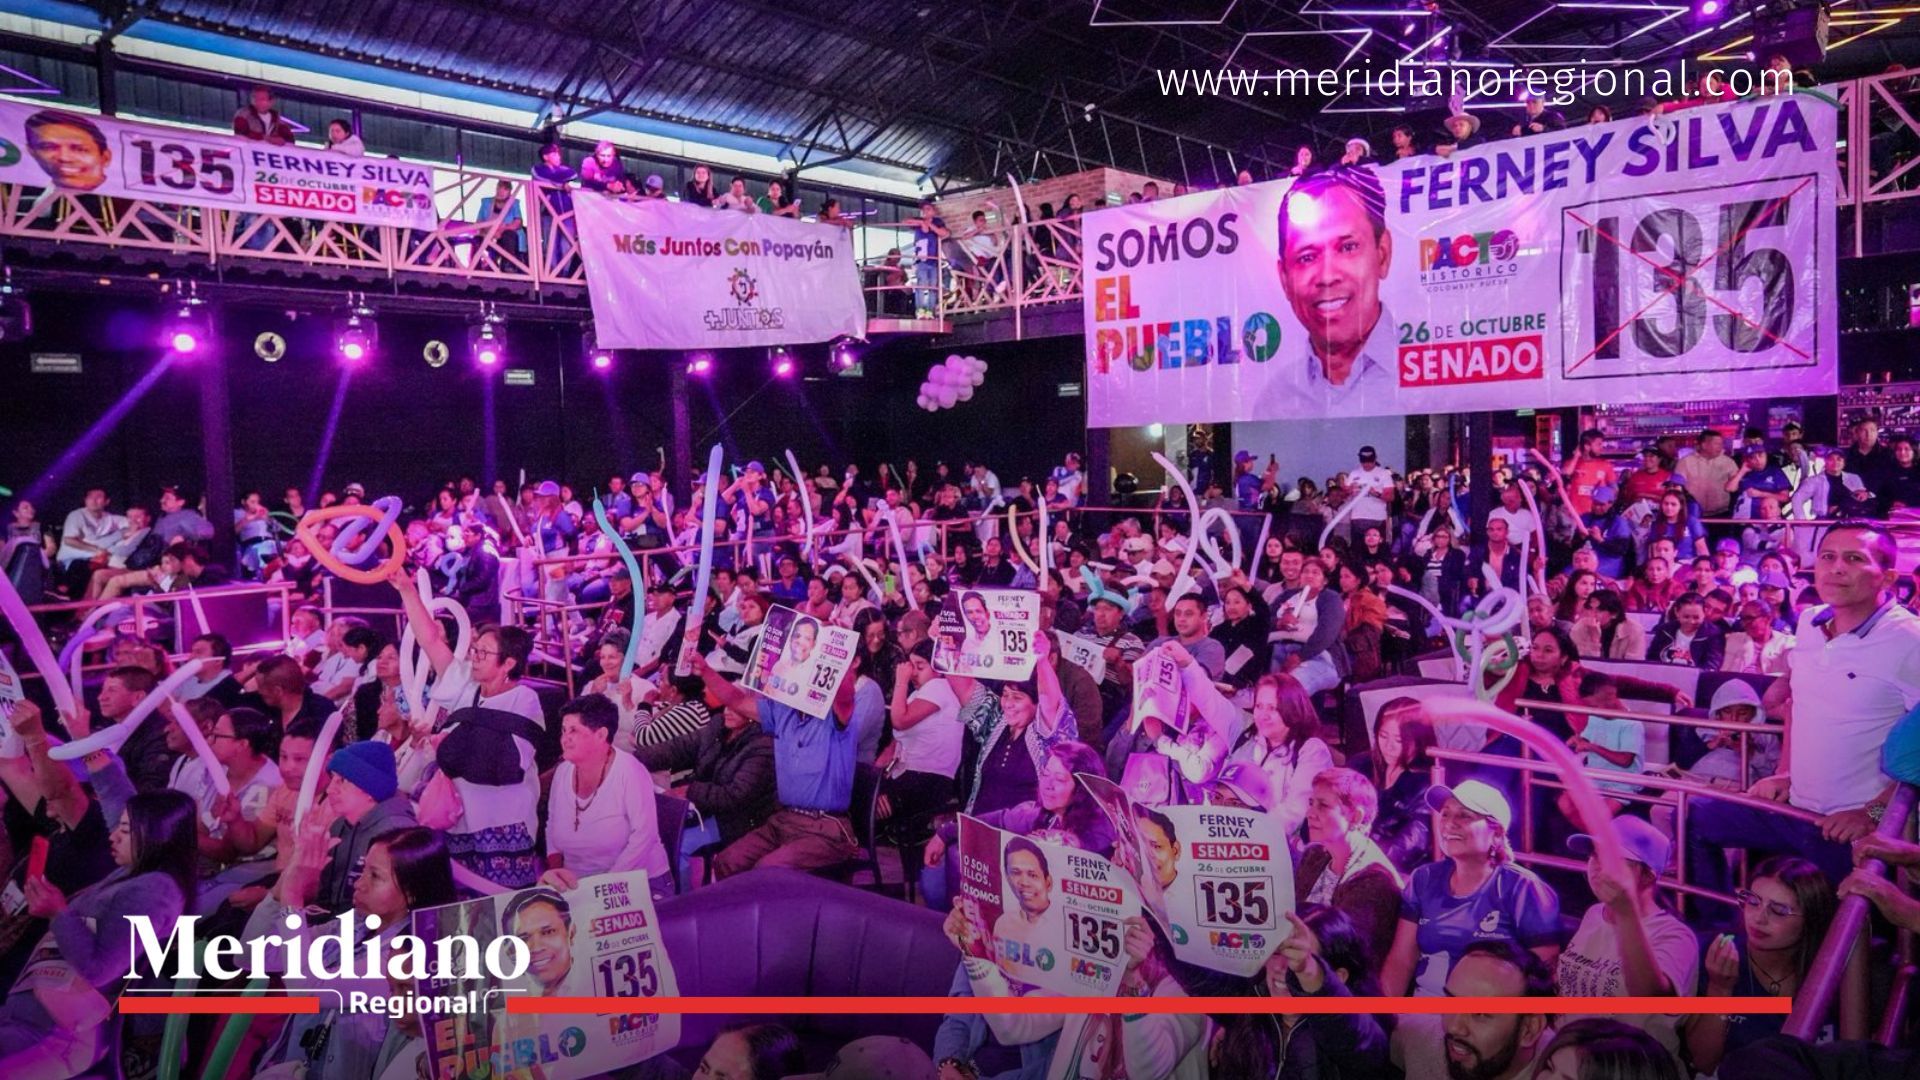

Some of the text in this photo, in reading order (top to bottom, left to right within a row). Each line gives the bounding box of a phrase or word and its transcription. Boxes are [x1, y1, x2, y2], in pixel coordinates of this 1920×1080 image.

[131, 139, 235, 195] 135
[1400, 99, 1818, 213] FERNEY SILVA
[252, 150, 431, 188] FERNEY SILVA
[254, 171, 279, 185] 26
[296, 178, 356, 192] OCTUBRE
[258, 186, 354, 211] SENADO
[362, 186, 432, 210] PACTO
[613, 234, 834, 262] Más Juntos Con Popayán
[1095, 213, 1239, 272] SOMOS
[1420, 229, 1520, 272] PACTO
[1576, 197, 1796, 361] 135
[1095, 275, 1140, 322] EL
[1400, 313, 1546, 345] 26 DE OCTUBRE
[1095, 311, 1282, 374] PUEBLO
[1402, 342, 1538, 383] SENADO
[1000, 629, 1028, 653] 135
[1074, 646, 1090, 665] 35
[812, 664, 839, 691] 135
[1159, 660, 1175, 686] 135
[1200, 814, 1255, 828] FERNEY
[1208, 826, 1249, 839] SILVA
[1067, 855, 1111, 873] FERNEY
[1198, 845, 1264, 859] SENADO
[970, 858, 990, 875] SON
[1073, 868, 1108, 882] SILVA
[1197, 863, 1214, 873] 26
[1225, 866, 1266, 874] OCTUBRE
[594, 881, 630, 898] FERNEY
[969, 886, 1000, 905] SOMOS
[1066, 880, 1118, 901] SENADO
[603, 895, 632, 910] SILVA
[1200, 881, 1268, 925] 135
[594, 911, 643, 934] SENADO
[596, 939, 610, 952] 26
[1068, 913, 1120, 960] 135
[1209, 931, 1266, 949] PACTO
[598, 949, 658, 997] 135
[1070, 956, 1112, 982] PACTO
[434, 1018, 476, 1052] EL
